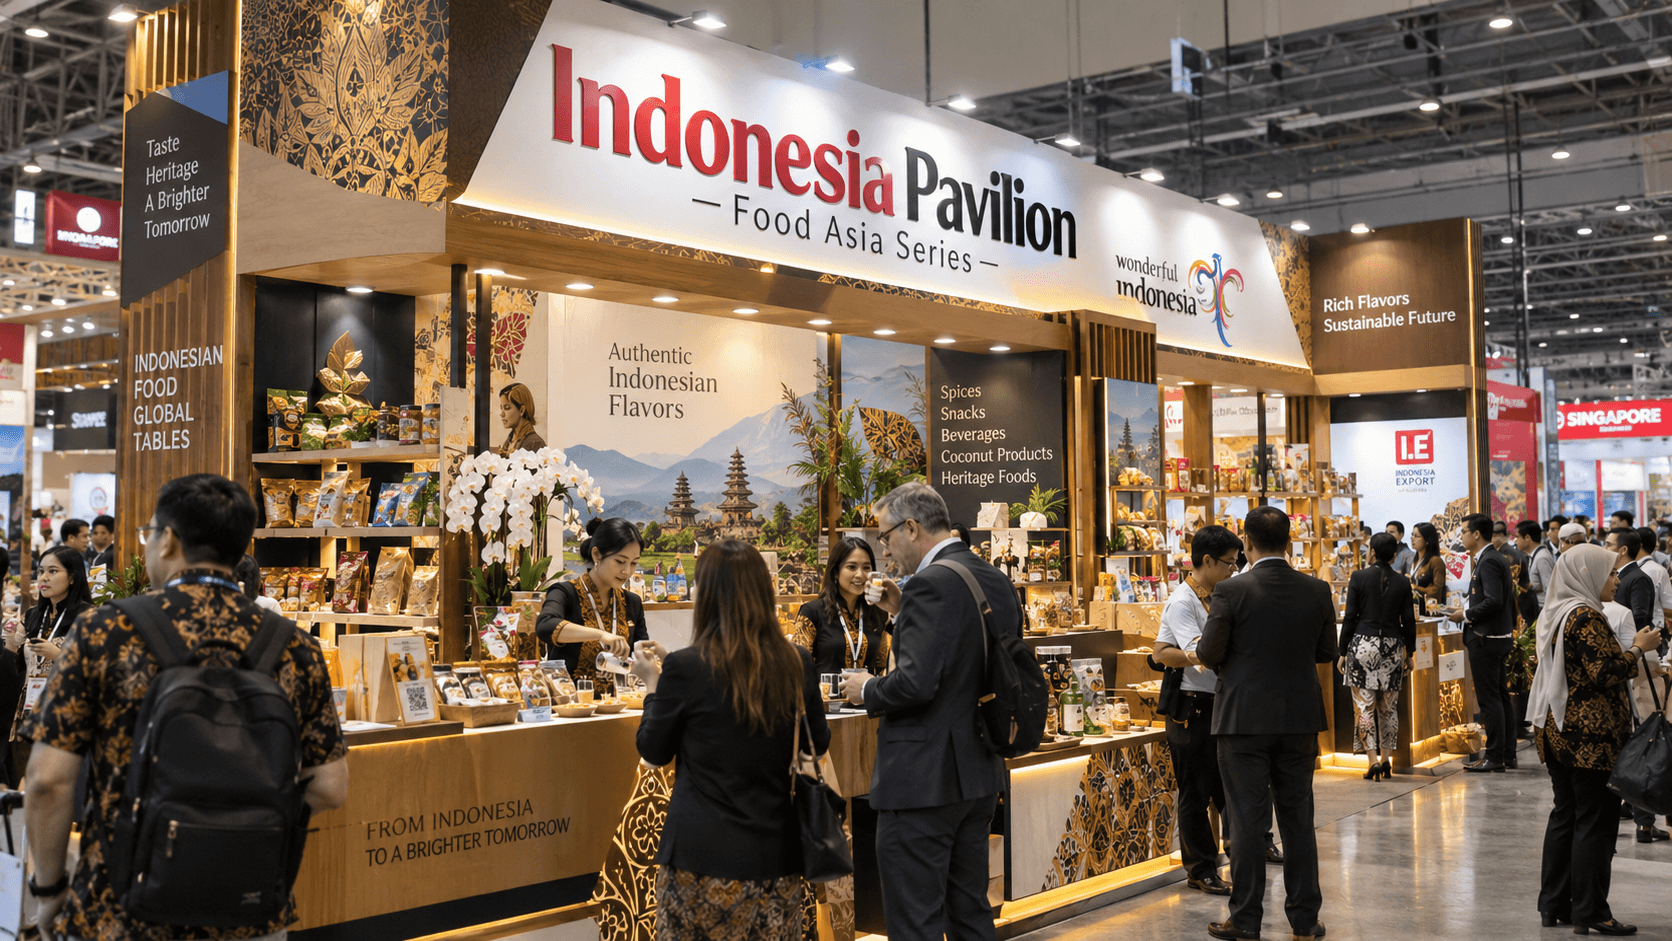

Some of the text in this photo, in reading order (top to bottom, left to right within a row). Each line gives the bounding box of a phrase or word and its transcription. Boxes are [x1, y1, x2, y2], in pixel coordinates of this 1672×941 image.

[146, 135, 180, 158] Taste
[551, 43, 1077, 259] Indonesia Pavilion
[146, 160, 199, 186] Heritage
[144, 184, 210, 213] A Brighter
[144, 213, 211, 239] Tomorrow
[733, 194, 972, 273] Food Asia Series
[1115, 254, 1179, 282] wonderful
[1323, 294, 1410, 313] Rich Flavors
[1324, 310, 1457, 333] Sustainable Future
[134, 344, 224, 374] INDONESIAN
[608, 342, 693, 365] Authentic
[134, 376, 178, 400] FOOD
[609, 366, 718, 393] Indonesian
[940, 384, 982, 403] Spices
[133, 402, 195, 426] GLOBAL
[609, 394, 684, 420] Flavors
[940, 404, 986, 421] Snacks
[1566, 407, 1662, 428] SINGAPORE
[132, 429, 191, 452] TABLES
[941, 428, 1006, 444] Beverages
[941, 446, 1053, 464] Coconut Products
[941, 468, 1037, 488] Heritage Foods
[1395, 469, 1436, 477] INDONESIA
[1395, 477, 1436, 486] EXPORT
[367, 798, 534, 841] FROM INDONESIA
[365, 816, 571, 868] TO A BRIGHTER TOMORROW
